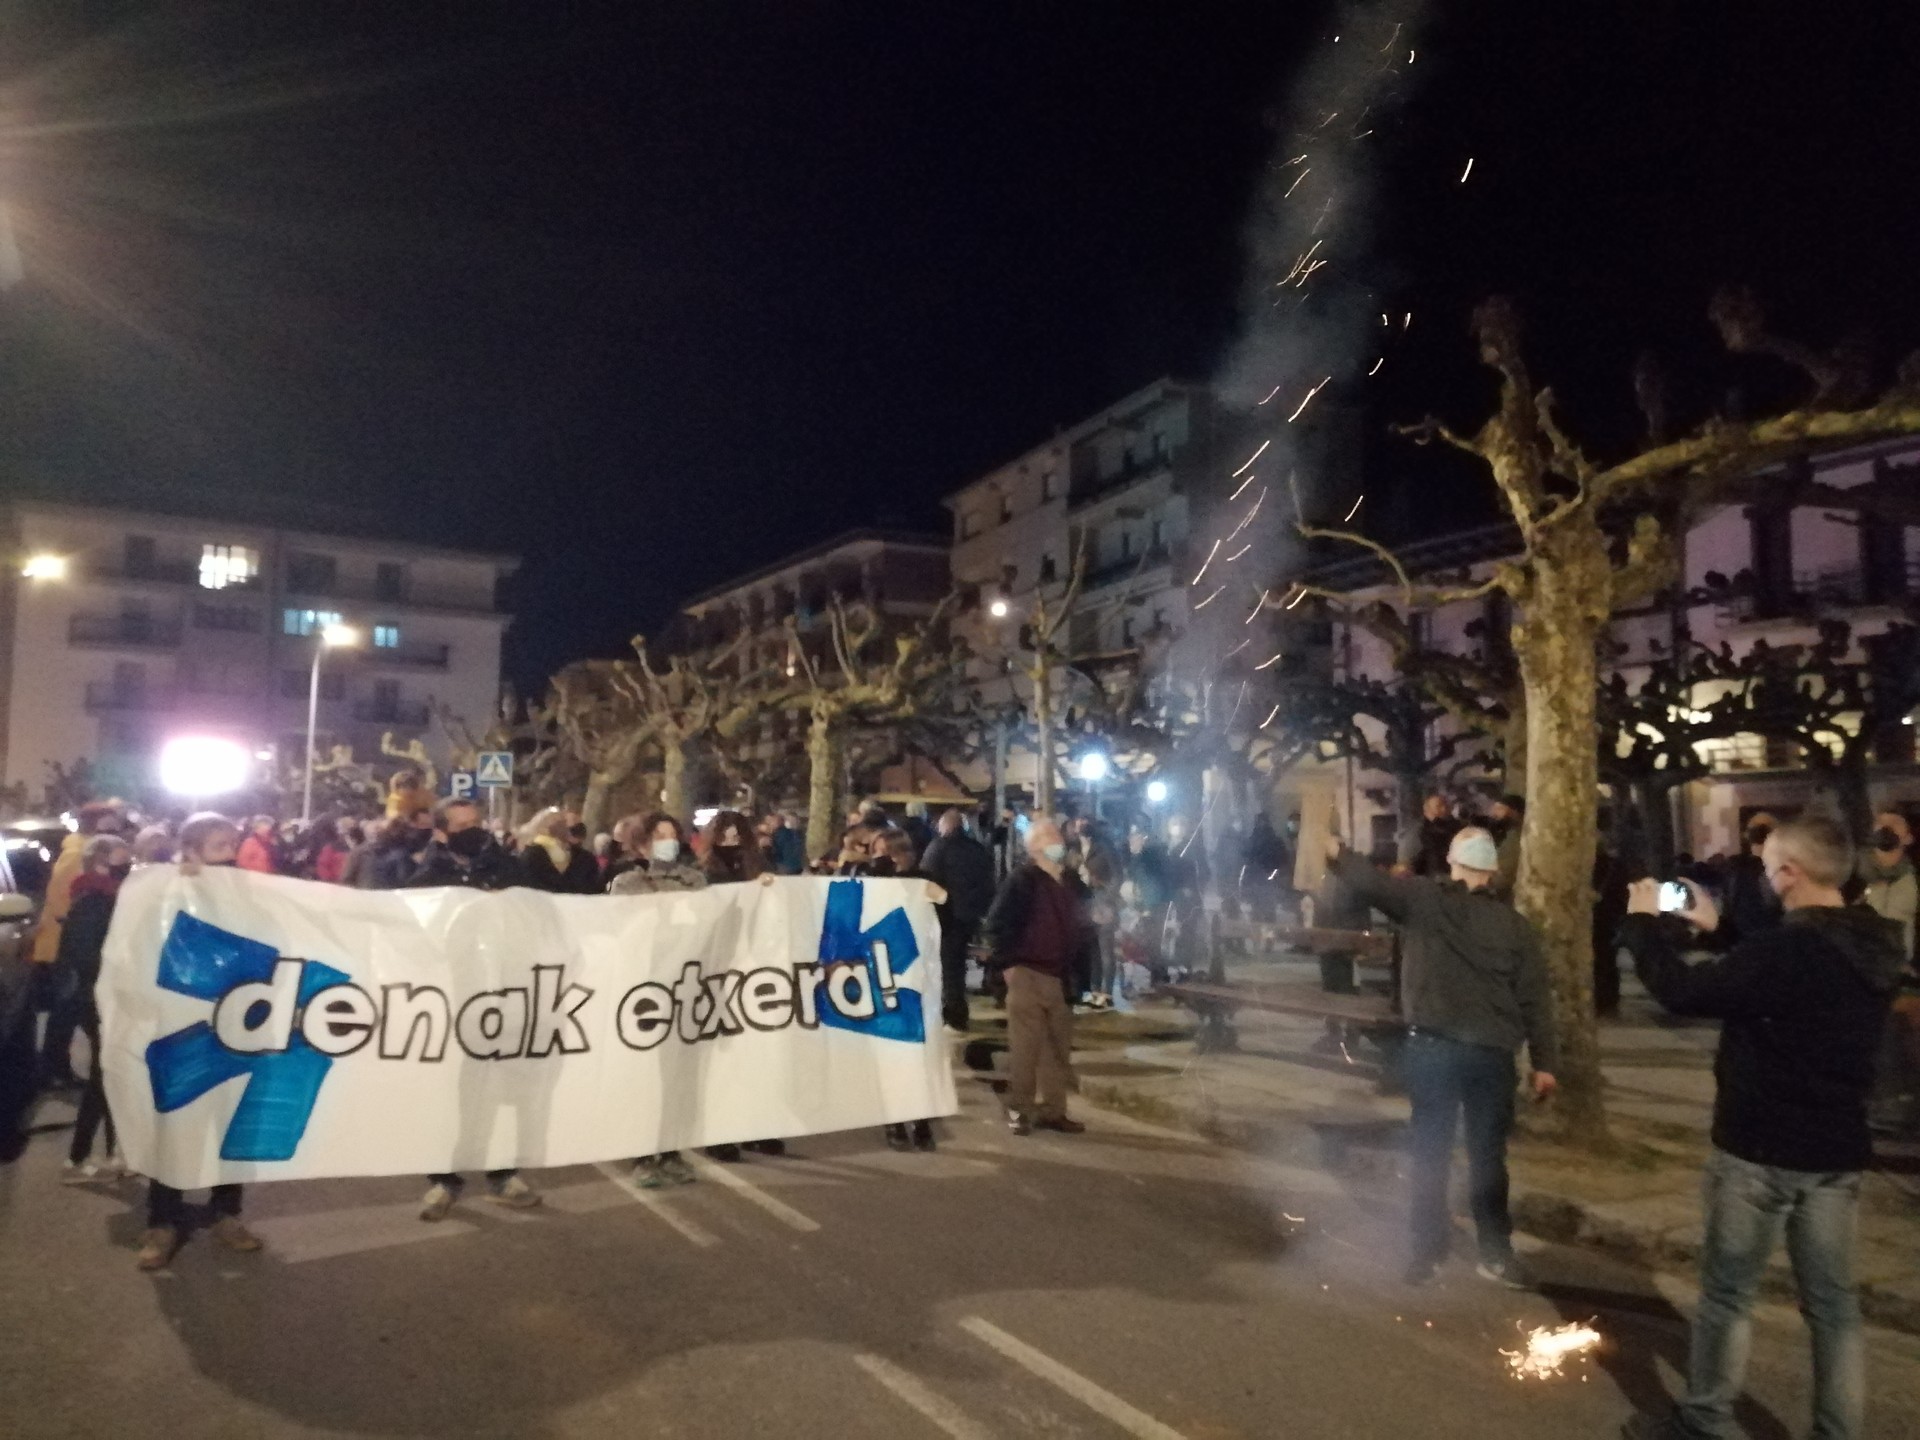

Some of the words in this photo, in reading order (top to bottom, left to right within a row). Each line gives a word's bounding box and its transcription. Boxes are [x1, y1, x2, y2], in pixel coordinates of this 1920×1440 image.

[451, 773, 473, 798] P
[213, 957, 593, 1062] denak
[616, 939, 902, 1051] etxera!
